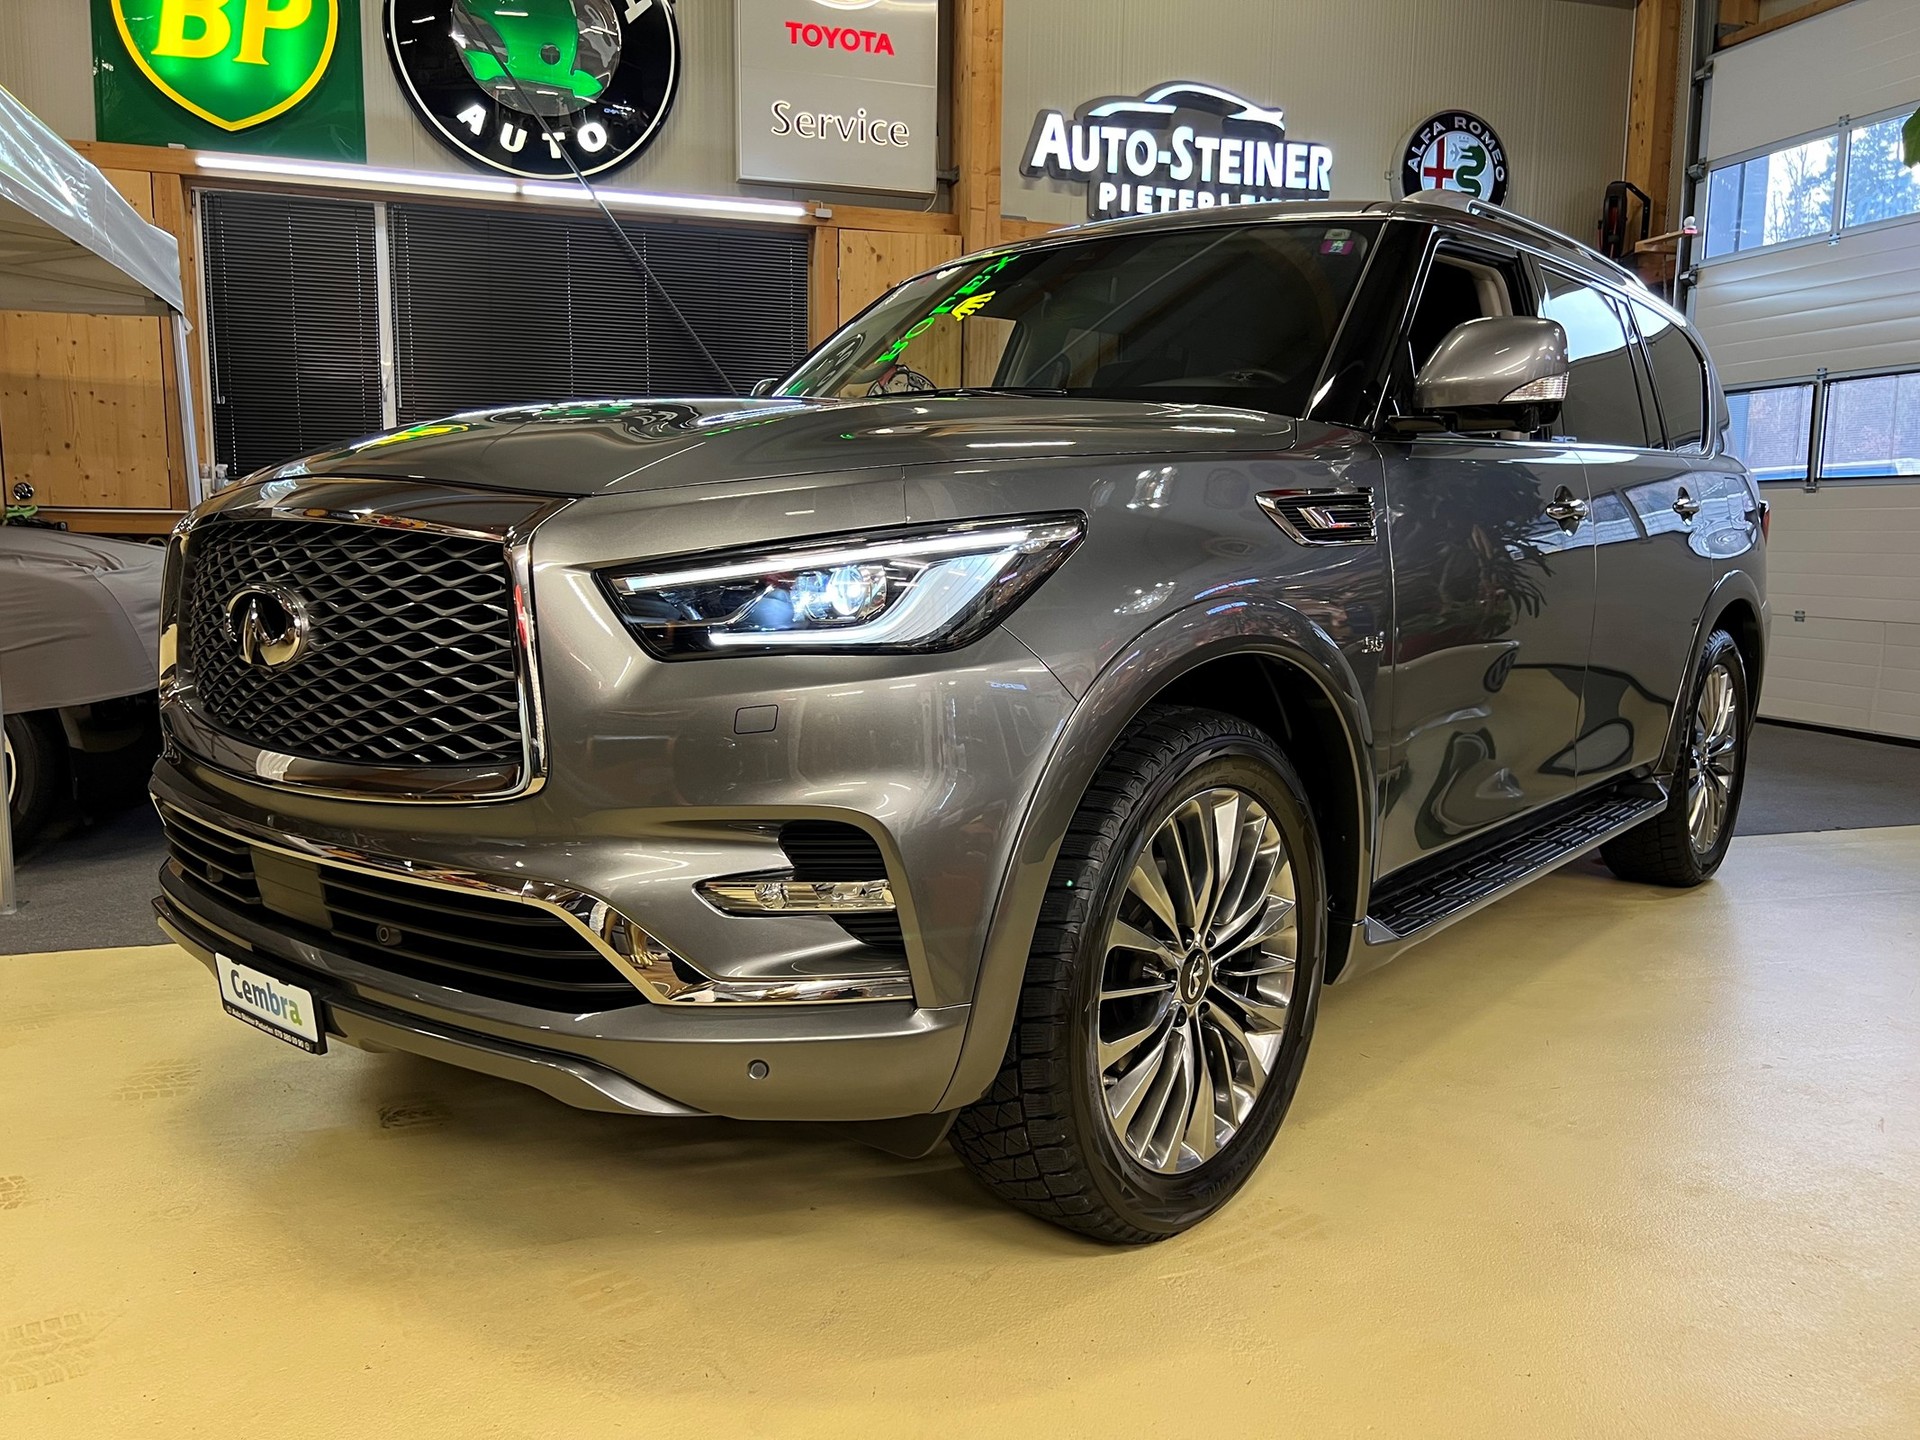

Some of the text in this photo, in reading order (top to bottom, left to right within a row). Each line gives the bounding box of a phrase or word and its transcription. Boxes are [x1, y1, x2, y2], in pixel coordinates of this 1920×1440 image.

[151, 0, 312, 65] BP
[785, 21, 895, 56] TOYOTA
[456, 104, 608, 159] AUTO
[770, 99, 910, 147] Service
[1407, 116, 1505, 182] ALFA ROMEO
[231, 969, 303, 1026] Cembra
